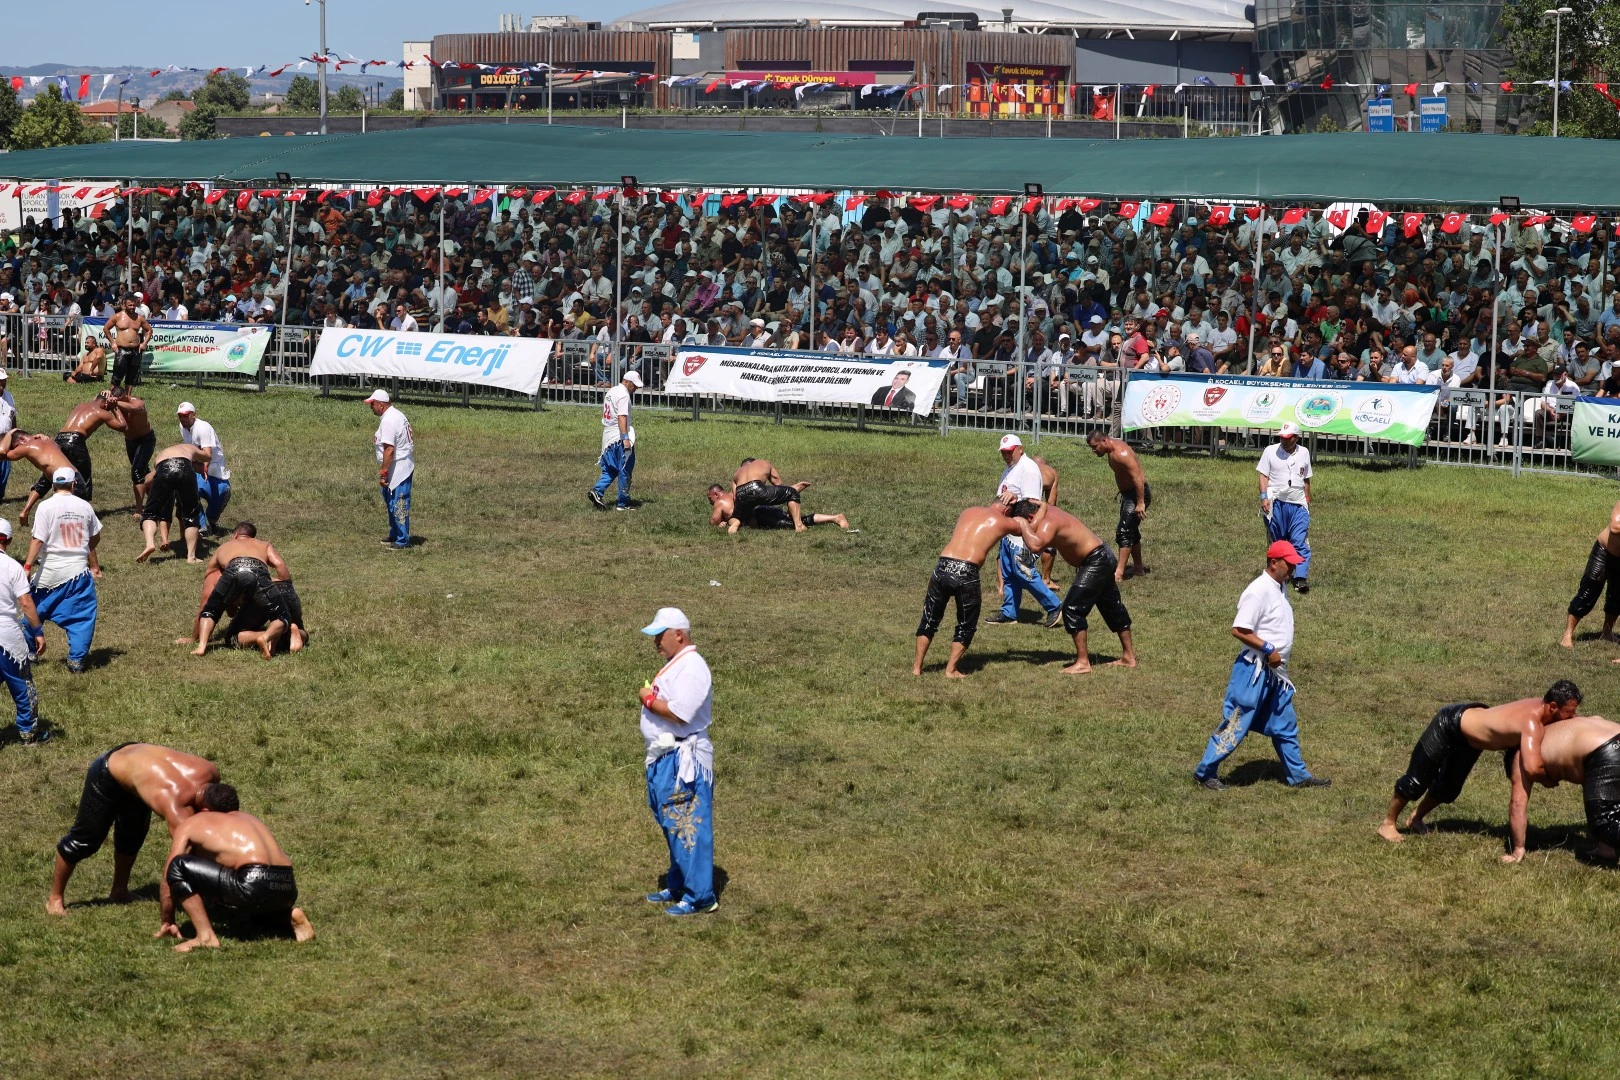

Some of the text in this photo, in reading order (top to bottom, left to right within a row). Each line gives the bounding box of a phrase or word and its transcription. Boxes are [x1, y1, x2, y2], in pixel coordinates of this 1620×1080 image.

[801, 75, 835, 83] Dünyası
[150, 335, 175, 343] PORCU,
[177, 334, 214, 343] ANTRENÖR
[336, 334, 512, 377] CW Enerji
[720, 359, 885, 377] MÜSABAKALARA KATILAN TÜM SPORCU, ANTRENÖR VE
[790, 375, 826, 384] BAŞARILAR
[825, 376, 852, 385] DİLERİM
[1589, 426, 1604, 436] VE
